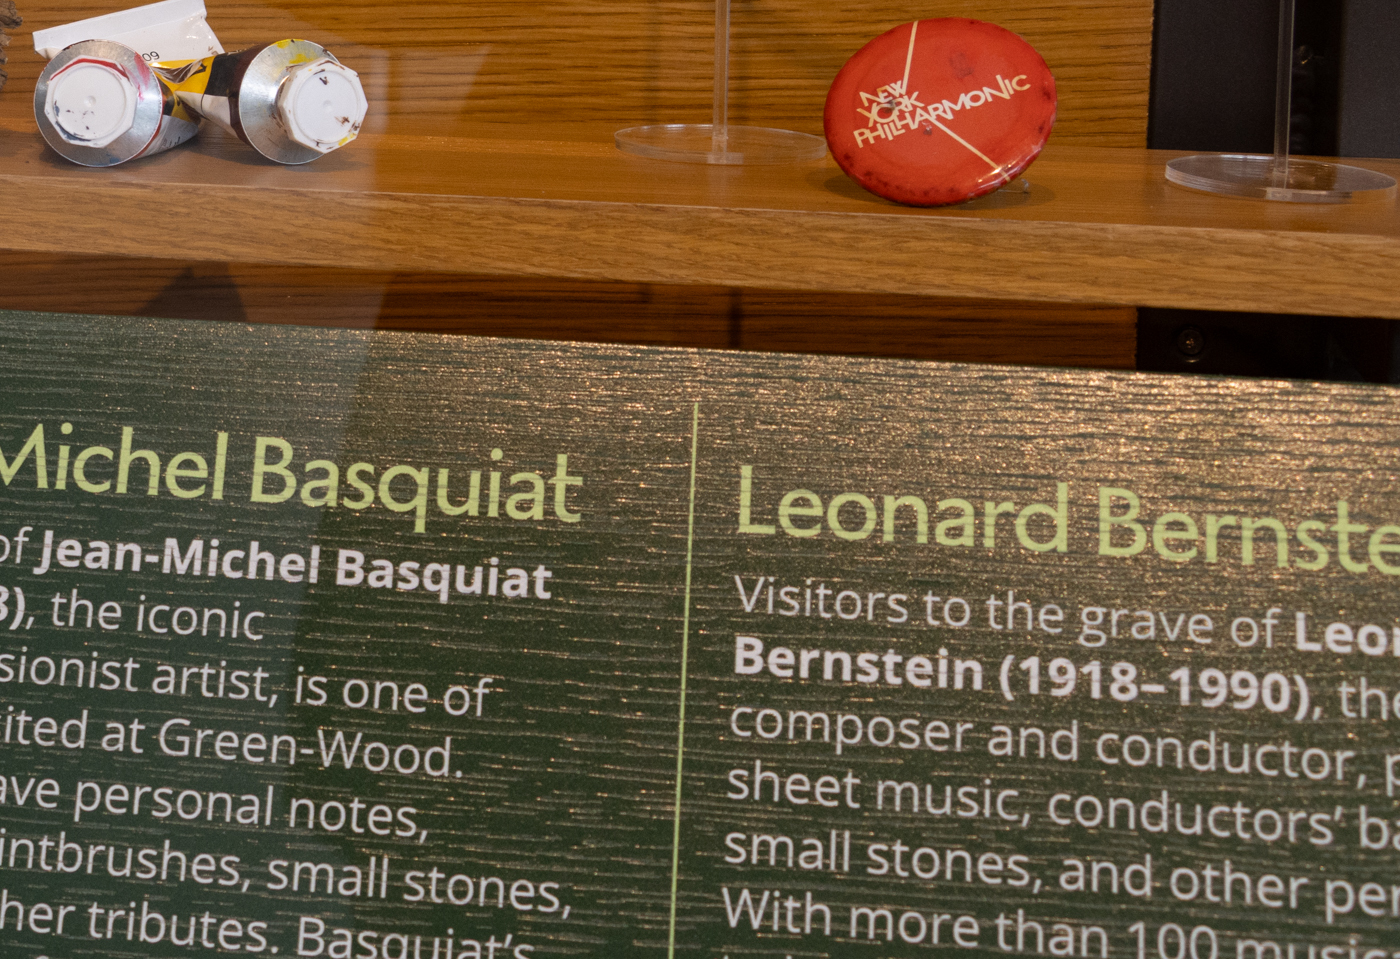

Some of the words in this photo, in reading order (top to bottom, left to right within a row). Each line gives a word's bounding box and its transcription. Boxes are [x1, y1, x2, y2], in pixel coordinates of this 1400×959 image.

[852, 74, 1032, 149] PHILHARMONIC
[856, 91, 925, 128] YORK
[859, 80, 905, 107] NEW
[249, 436, 583, 534] Basquiat
[737, 465, 1068, 554] Leonard
[29, 527, 322, 585] Jean-Michel
[335, 548, 553, 605] Basquiat
[51, 588, 123, 631] the
[136, 594, 266, 642] iconic
[733, 574, 909, 625] Visitors
[923, 590, 972, 630] to
[985, 589, 1066, 636] the
[1076, 605, 1215, 649] grave
[1229, 606, 1282, 649] of
[150, 660, 279, 709] artist,
[294, 666, 328, 707] is
[342, 679, 429, 714] one
[442, 677, 493, 718] of
[733, 635, 984, 692] Bernstein
[100, 718, 146, 755] at
[157, 717, 463, 779] Green-Wood.
[729, 706, 974, 756] composer
[987, 719, 1080, 762] and
[1095, 730, 1367, 790] conductor,
[73, 781, 275, 827] personal
[288, 797, 428, 845] notes,
[727, 759, 861, 810] sheet
[876, 778, 1031, 829] music,
[1047, 790, 1344, 847] conductors'
[266, 856, 390, 899] small
[403, 867, 572, 920] stones,
[724, 829, 851, 873] small
[866, 840, 1042, 895] stones,
[1058, 853, 1153, 898] and
[1169, 859, 1310, 909] other
[88, 901, 279, 955] tributes.
[721, 887, 832, 936] With
[849, 907, 981, 949] more
[995, 909, 1109, 959] than
[1128, 921, 1220, 959] 100
